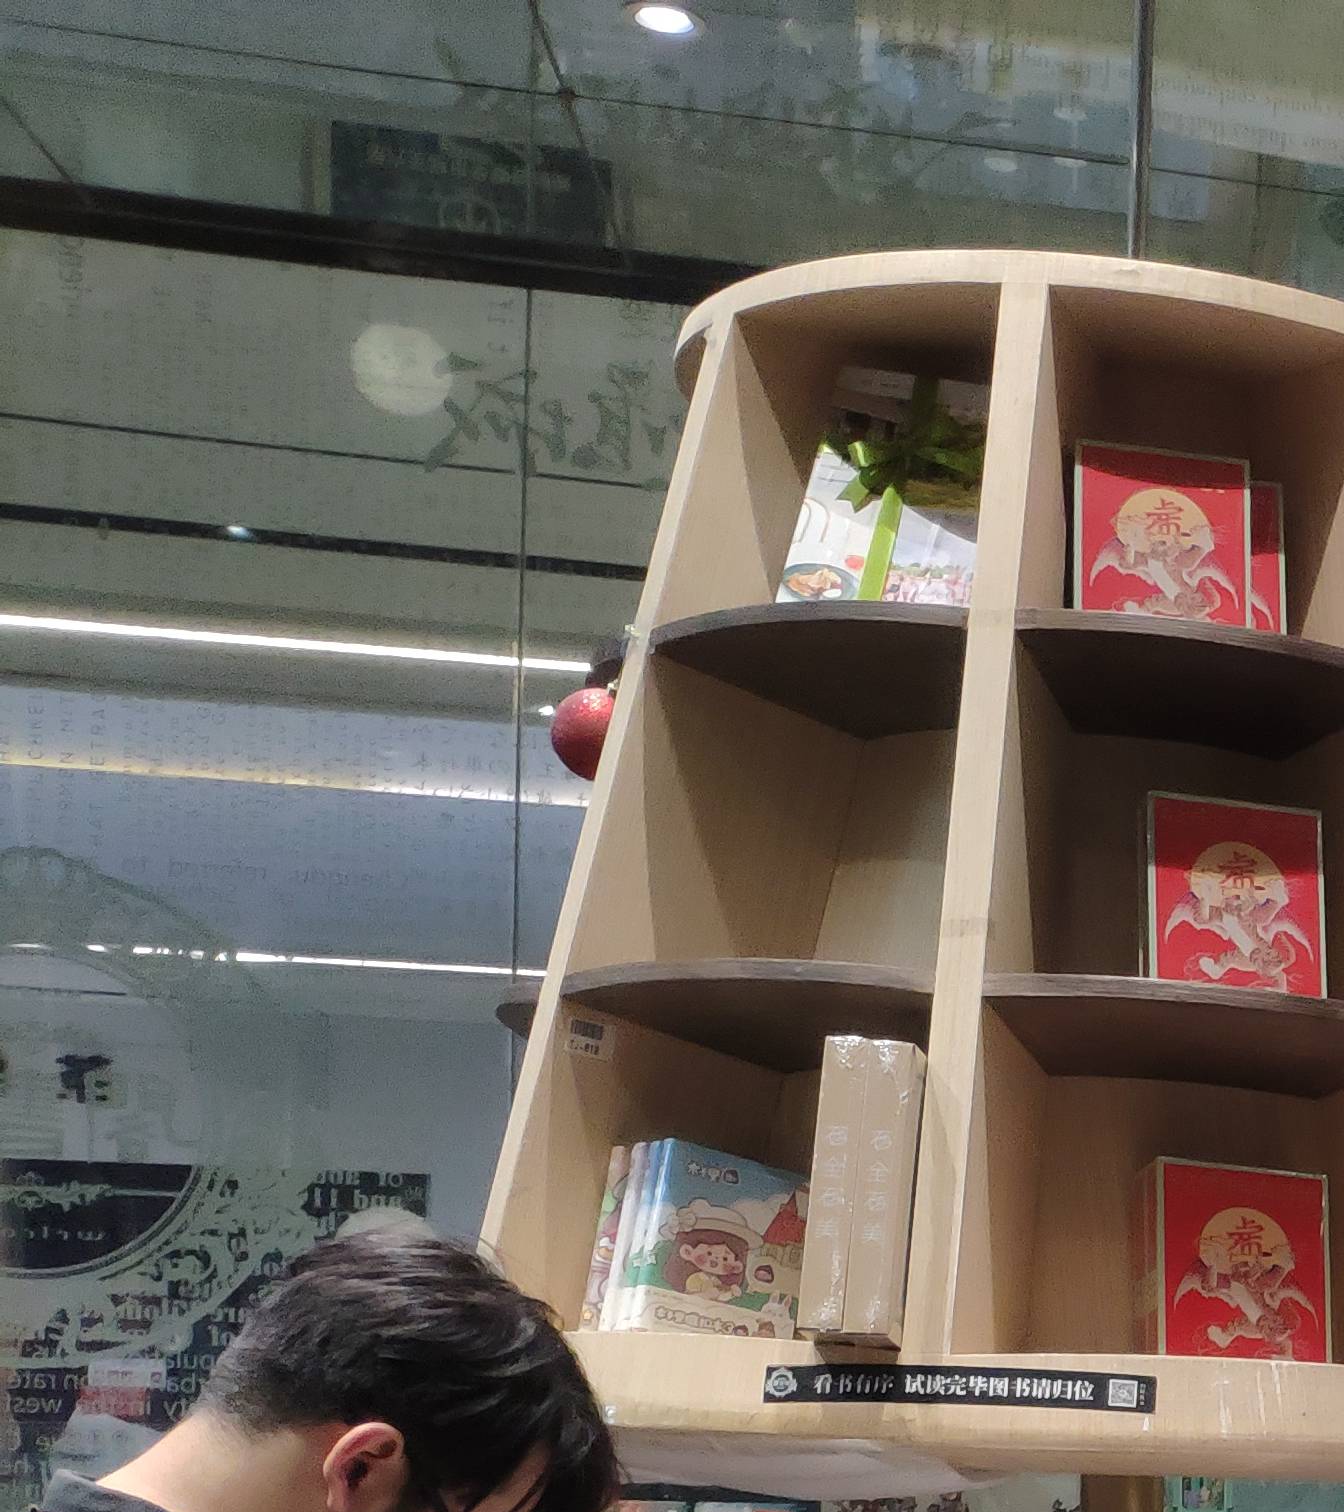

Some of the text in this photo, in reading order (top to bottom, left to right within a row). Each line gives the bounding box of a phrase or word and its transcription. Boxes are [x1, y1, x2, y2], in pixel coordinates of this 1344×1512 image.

[904, 1374, 1094, 1400] 试读完毕图书请归位
